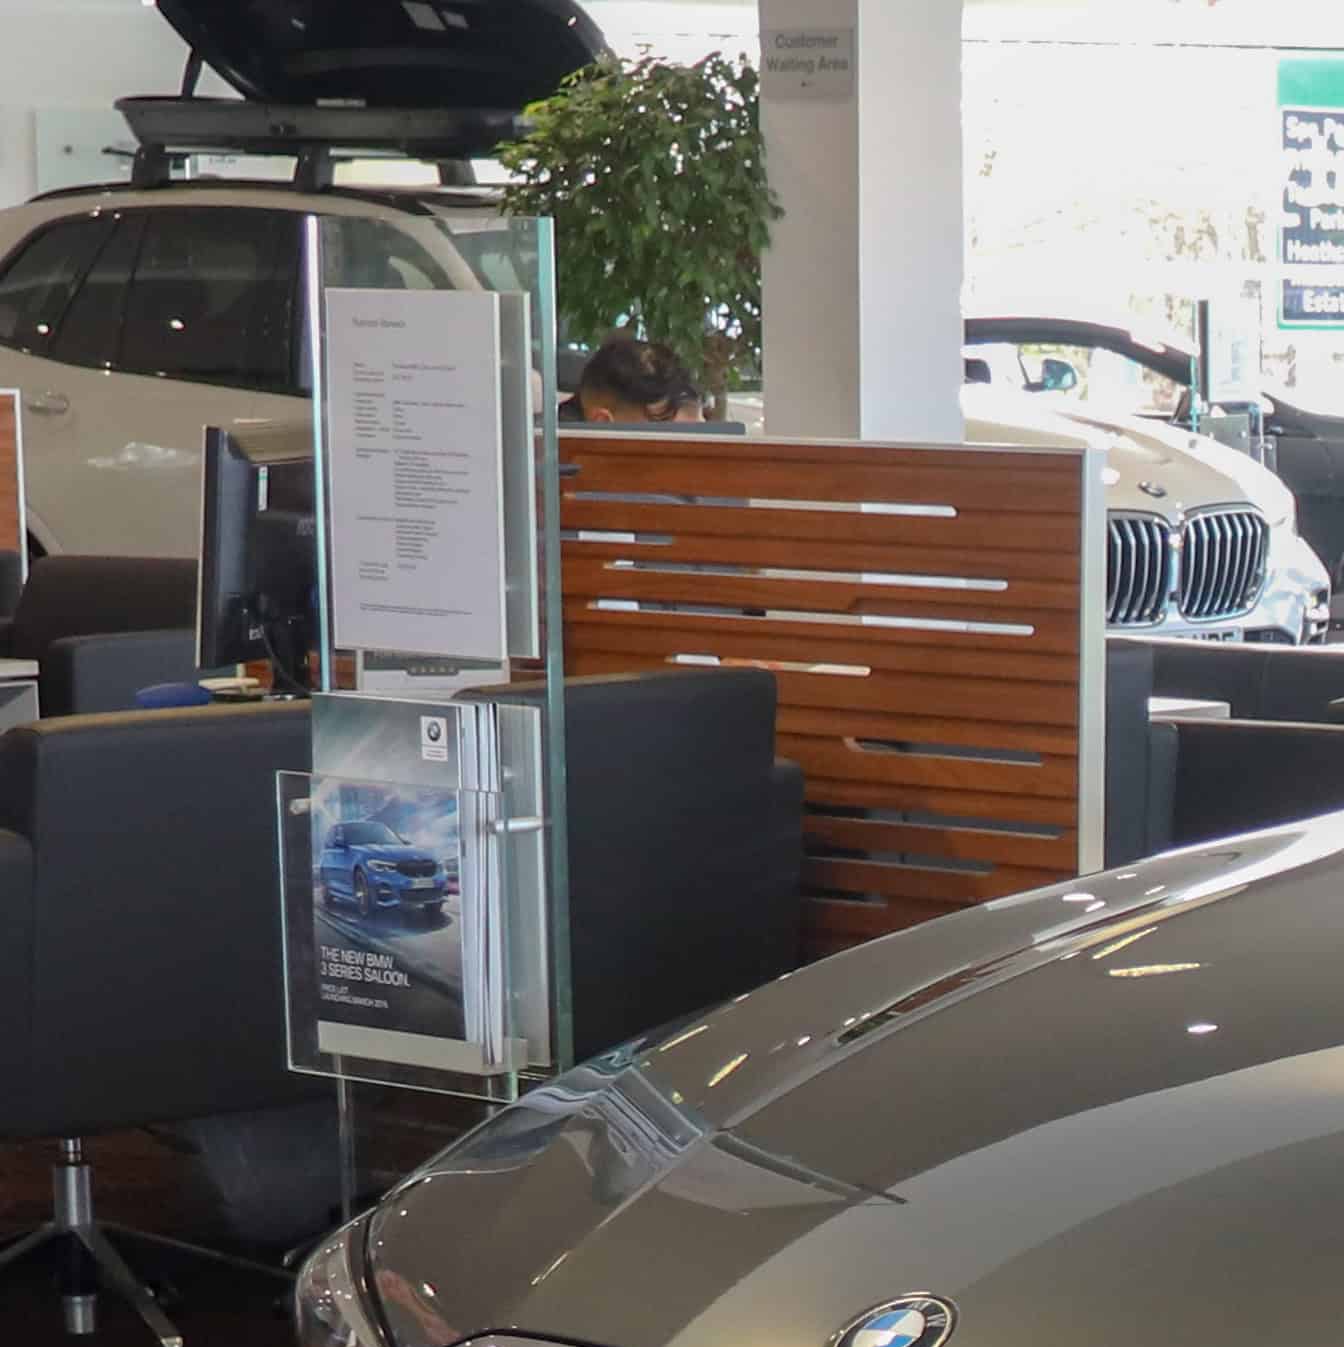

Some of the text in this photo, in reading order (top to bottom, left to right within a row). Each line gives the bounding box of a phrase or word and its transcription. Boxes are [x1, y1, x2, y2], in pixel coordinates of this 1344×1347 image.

[776, 32, 838, 49] Customer
[766, 56, 849, 75] Waiting Area
[320, 945, 393, 969] THE NEW BMW
[319, 961, 328, 976] 3
[328, 963, 362, 981] SERIES
